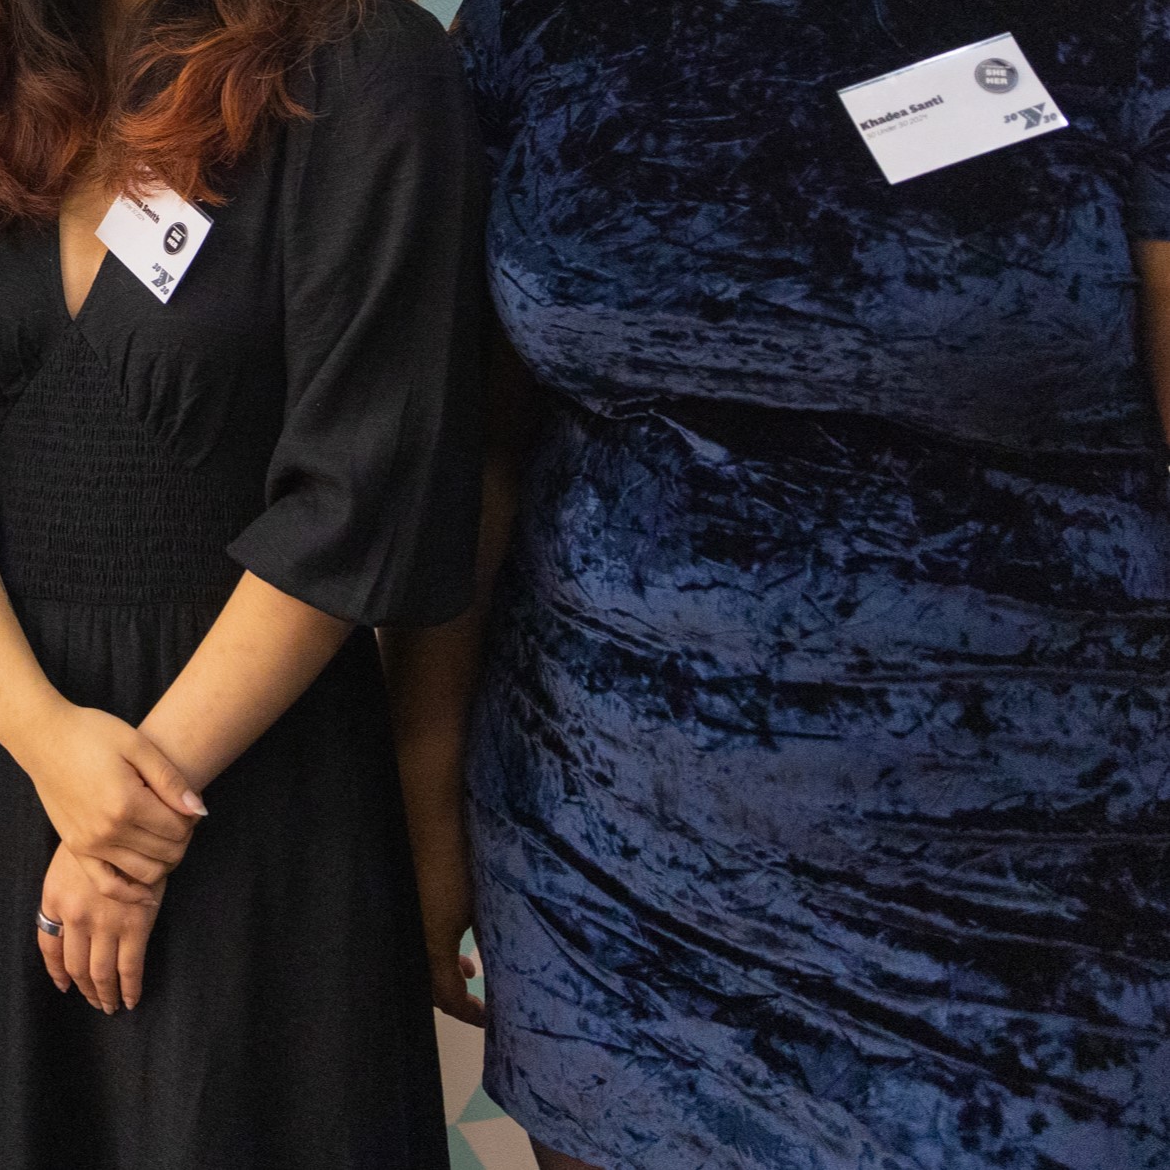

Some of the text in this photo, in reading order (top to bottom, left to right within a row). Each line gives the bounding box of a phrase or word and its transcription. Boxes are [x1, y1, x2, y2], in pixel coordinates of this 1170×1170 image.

[859, 95, 944, 132] Khadea Santi
[1003, 112, 1018, 124] 30
[1043, 112, 1058, 124] 30
[142, 205, 160, 224] Smith
